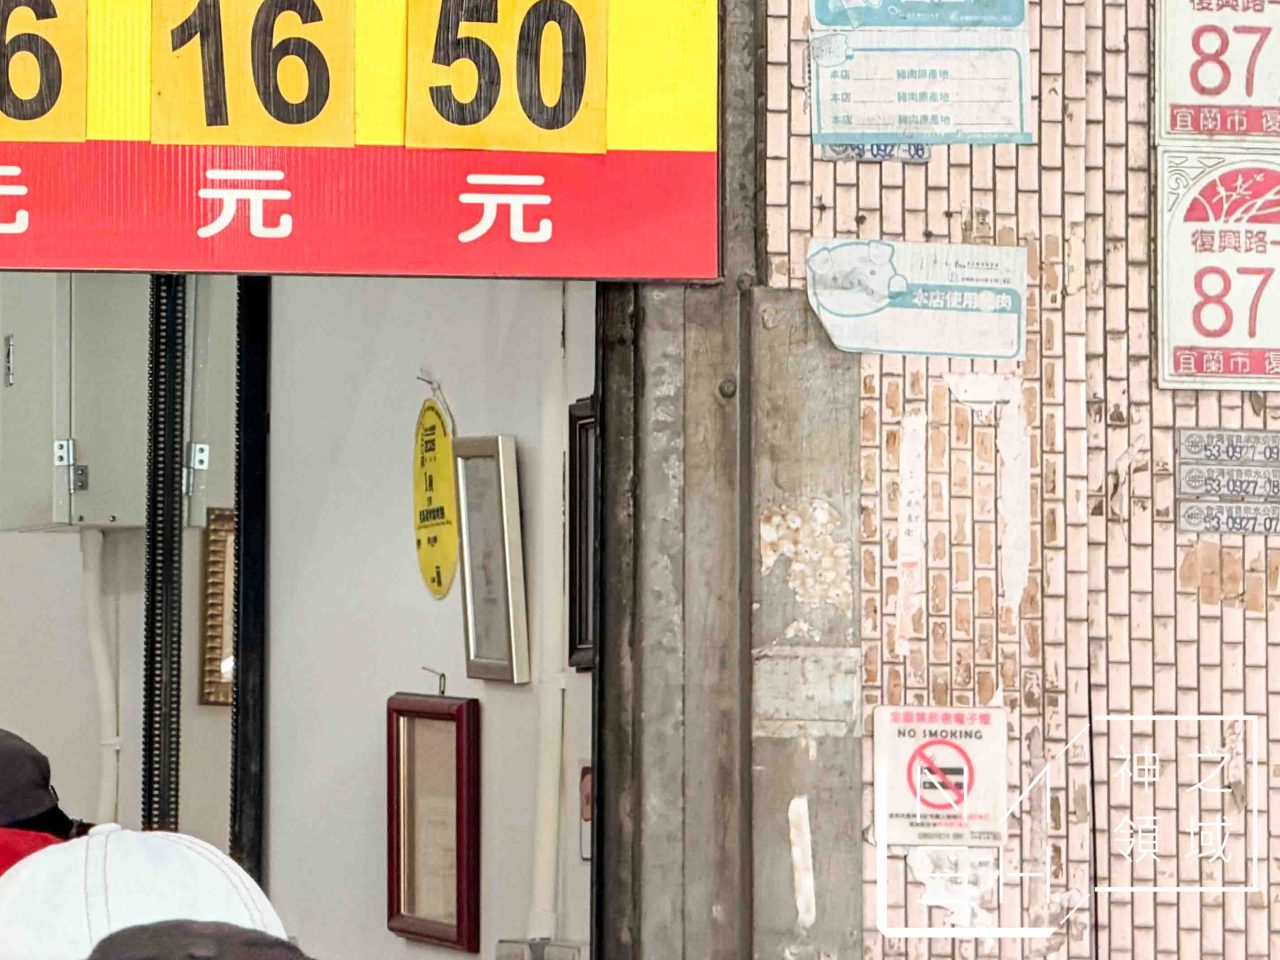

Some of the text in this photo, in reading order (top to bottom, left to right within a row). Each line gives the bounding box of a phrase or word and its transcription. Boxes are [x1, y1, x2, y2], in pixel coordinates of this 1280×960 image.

[1190, 24, 1273, 97] 87
[1174, 108, 1247, 131] 宜蘭市
[198, 169, 293, 239] 元
[458, 174, 553, 243] 元
[912, 289, 1011, 311] 本店使用肉
[1192, 266, 1275, 338] 87
[1177, 350, 1250, 373] 宜蘭市
[897, 728, 983, 739] NO SMOKING
